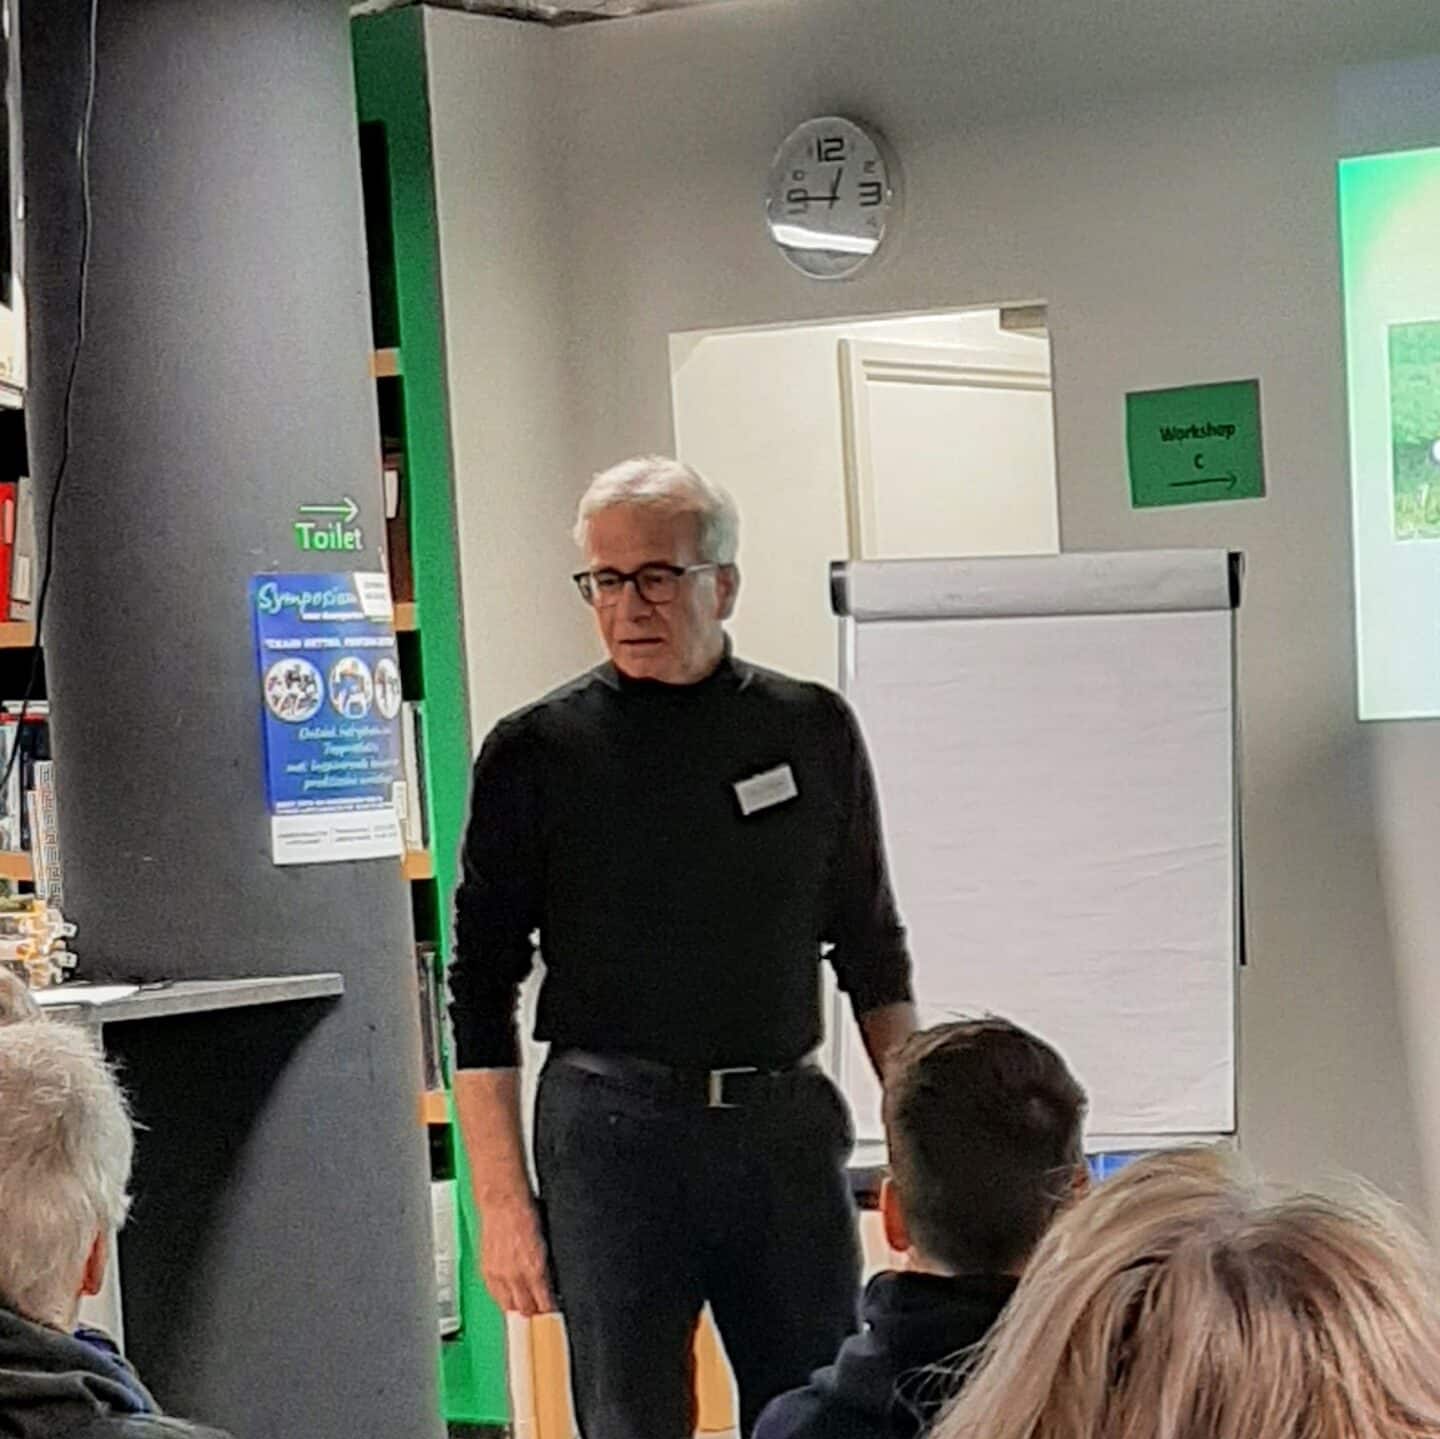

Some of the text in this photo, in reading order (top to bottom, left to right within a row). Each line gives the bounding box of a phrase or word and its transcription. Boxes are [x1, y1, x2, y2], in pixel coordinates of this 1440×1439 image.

[816, 137, 846, 163] 12
[858, 181, 883, 207] 3
[1159, 421, 1236, 443] Workshop
[1193, 453, 1205, 470] C
[294, 521, 364, 550] Toilet
